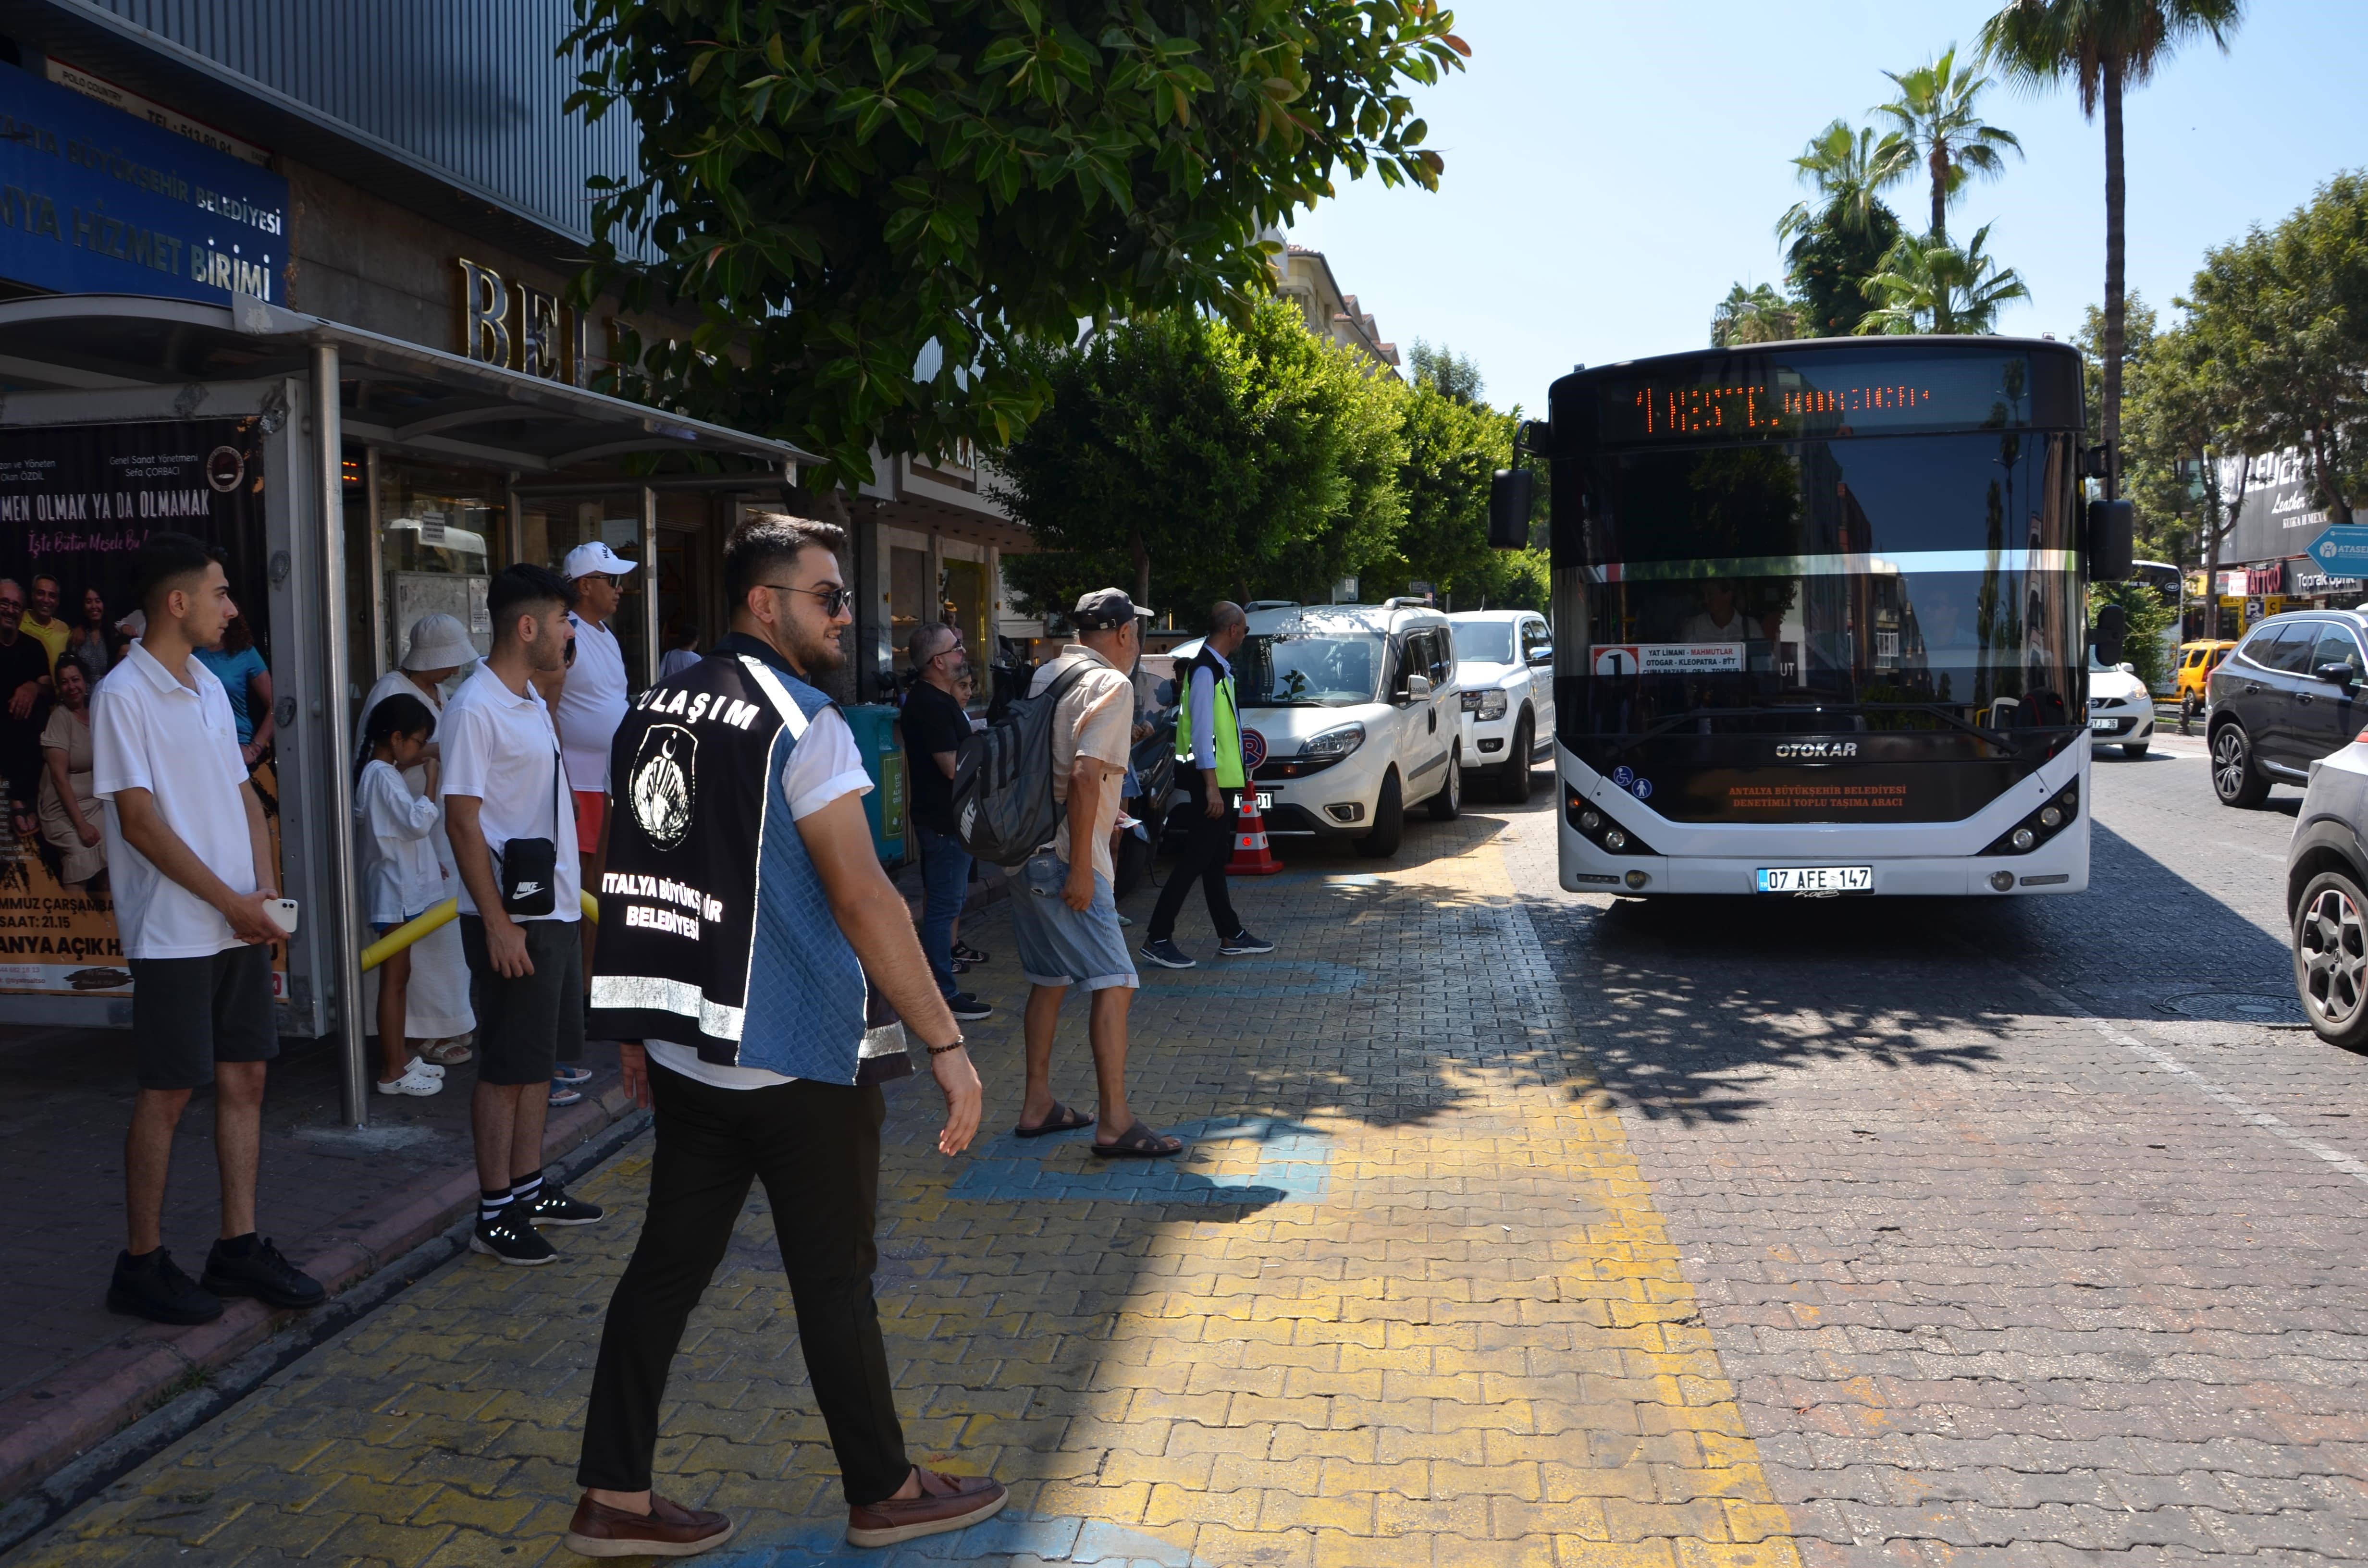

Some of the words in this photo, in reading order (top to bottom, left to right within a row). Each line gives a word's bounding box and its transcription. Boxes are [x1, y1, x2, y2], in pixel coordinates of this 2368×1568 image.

[62, 71, 86, 87] POLO
[0, 114, 60, 158] ALYA
[67, 135, 189, 203] BÜYÜKŞEHİR
[196, 186, 281, 236] BELEDİYESİ
[73, 199, 182, 275] HİZMET
[192, 236, 270, 302] BİRİMİ
[24, 459, 56, 468] Yöneten
[110, 456, 129, 465] Genel
[131, 455, 155, 464] Sanat
[158, 453, 198, 463] Yönetmeni
[20, 470, 45, 480] ÖZDİL
[125, 468, 143, 477] Sefa
[146, 466, 180, 478] ÇORBACI
[37, 493, 87, 521] OLMAK
[92, 493, 111, 520] YA
[116, 491, 134, 519] DA
[139, 489, 210, 518] OLMAMAK
[2271, 490, 2306, 514] Leather
[28, 530, 51, 559] İşte
[54, 530, 87, 552] Bütün
[2245, 563, 2282, 595] TATTOO
[2297, 572, 2328, 589] Toprak
[1662, 648, 1685, 656] LİMANI
[1776, 742, 1857, 757] OTOKAR
[1729, 787, 1772, 796] ANTALYA
[1775, 784, 1841, 796] BÜYÜKŞEHİR
[1844, 784, 1907, 795] BELEDİYESİ
[1733, 797, 1791, 807] DENETİMLİ
[1830, 798, 1869, 808] TAŞIMA
[1872, 798, 1903, 807] ARACI
[960, 796, 976, 844] NIKE
[516, 882, 539, 892] NIKE
[1769, 871, 1788, 889] 07
[1798, 870, 1826, 888] AFE
[1839, 870, 1868, 887] 147
[43, 898, 114, 915] ÇARŞAMBA
[0, 916, 39, 928] SAAT:
[42, 917, 71, 928] 21.15
[626, 906, 699, 941] BELEDİYESİ
[57, 937, 104, 961] AÇIK
